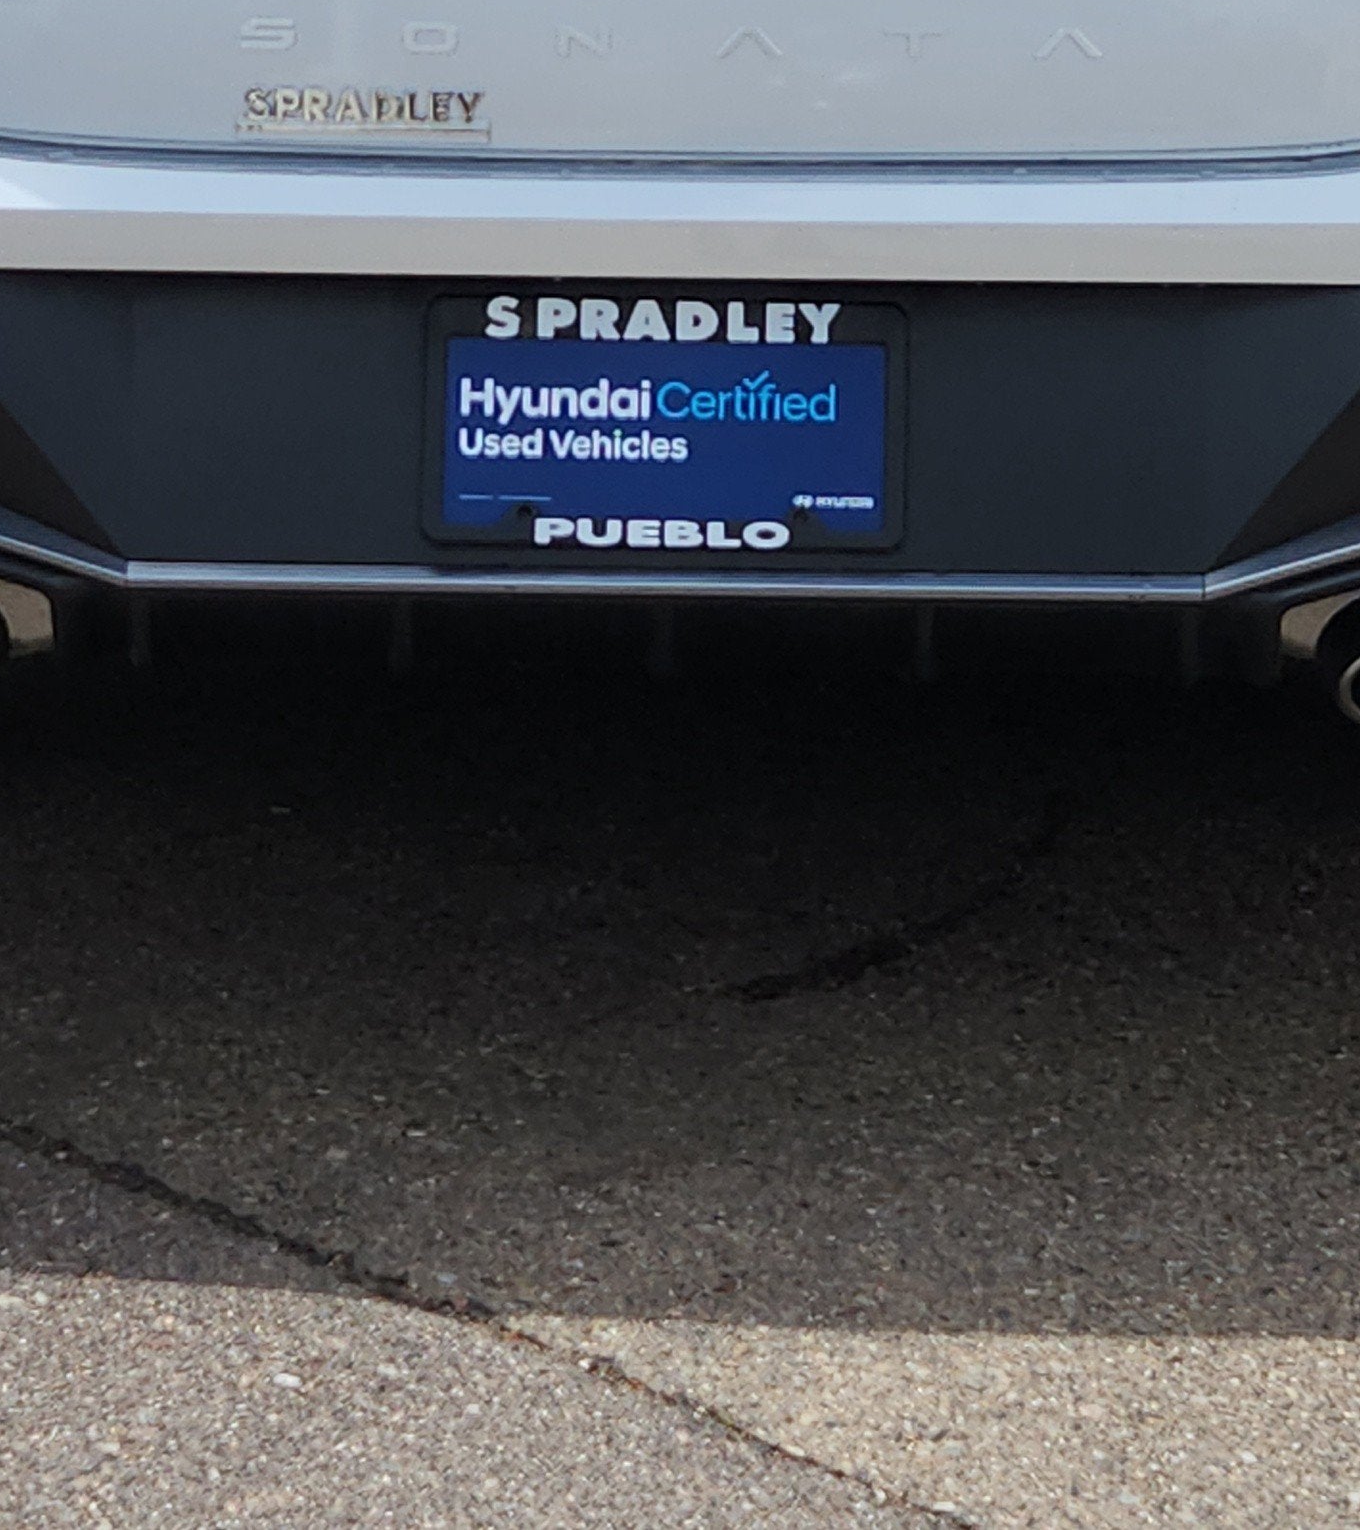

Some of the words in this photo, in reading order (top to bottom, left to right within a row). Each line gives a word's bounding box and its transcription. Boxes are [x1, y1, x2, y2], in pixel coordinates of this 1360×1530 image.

[240, 17, 1103, 59] SONATA
[244, 85, 484, 123] SPRADLEY
[459, 376, 651, 424] Hyundai
[656, 371, 836, 422] Certified
[458, 427, 543, 458] Used
[548, 428, 689, 461] Vehicles
[534, 517, 791, 550] PUEBLO
